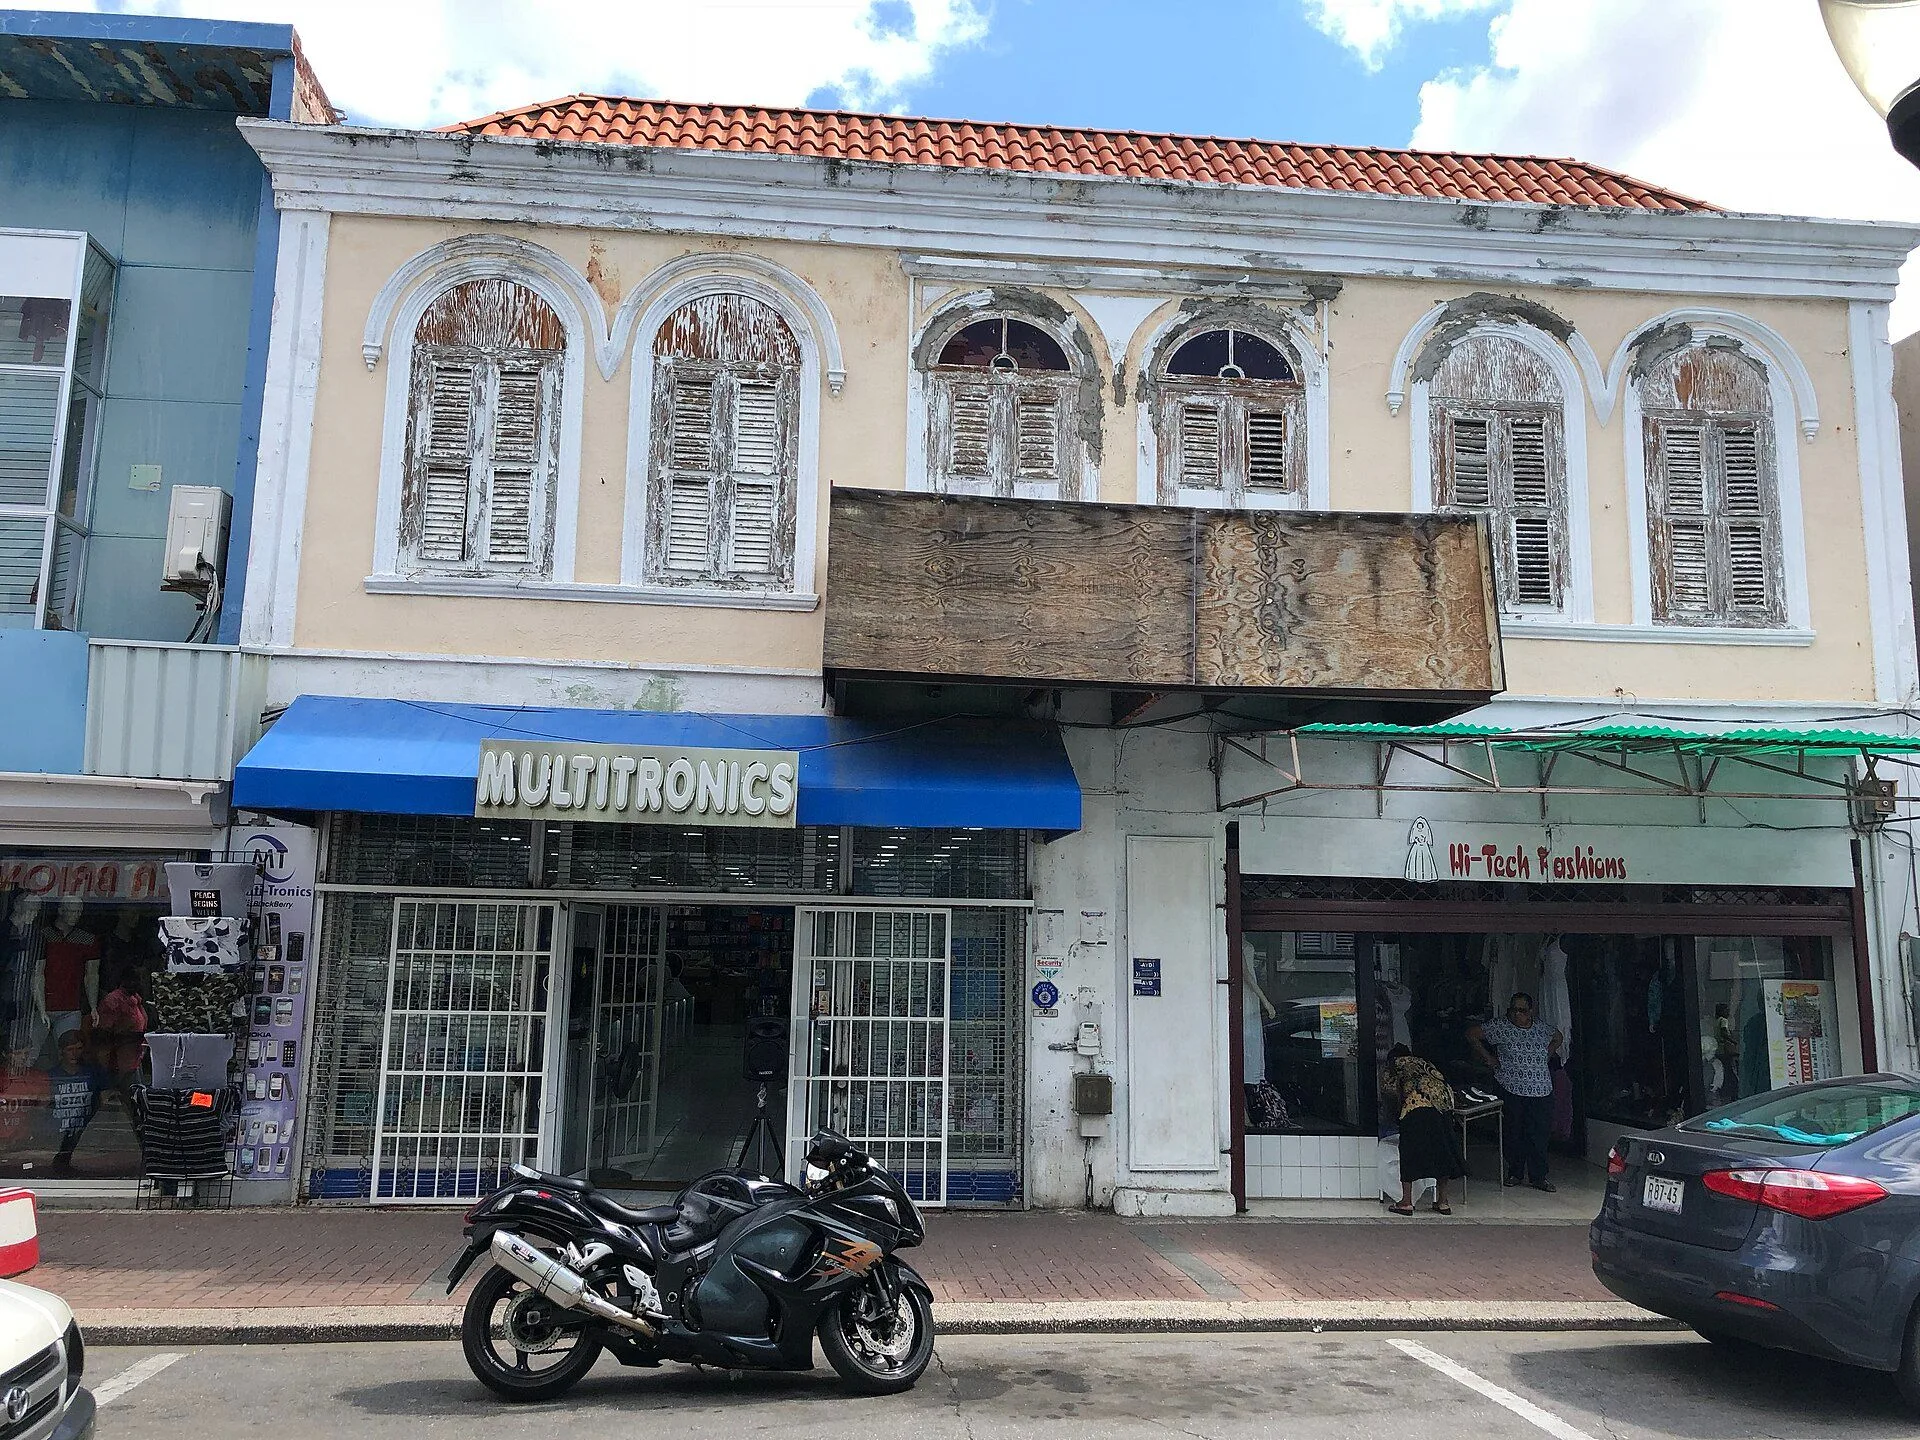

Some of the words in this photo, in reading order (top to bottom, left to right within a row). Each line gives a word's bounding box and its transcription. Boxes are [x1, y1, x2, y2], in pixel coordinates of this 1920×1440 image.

[477, 750, 795, 815] MULTITRONICS
[1449, 843, 1531, 880] Hi-Tech
[193, 900, 219, 908] BEGINS
[194, 891, 217, 899] PEACE
